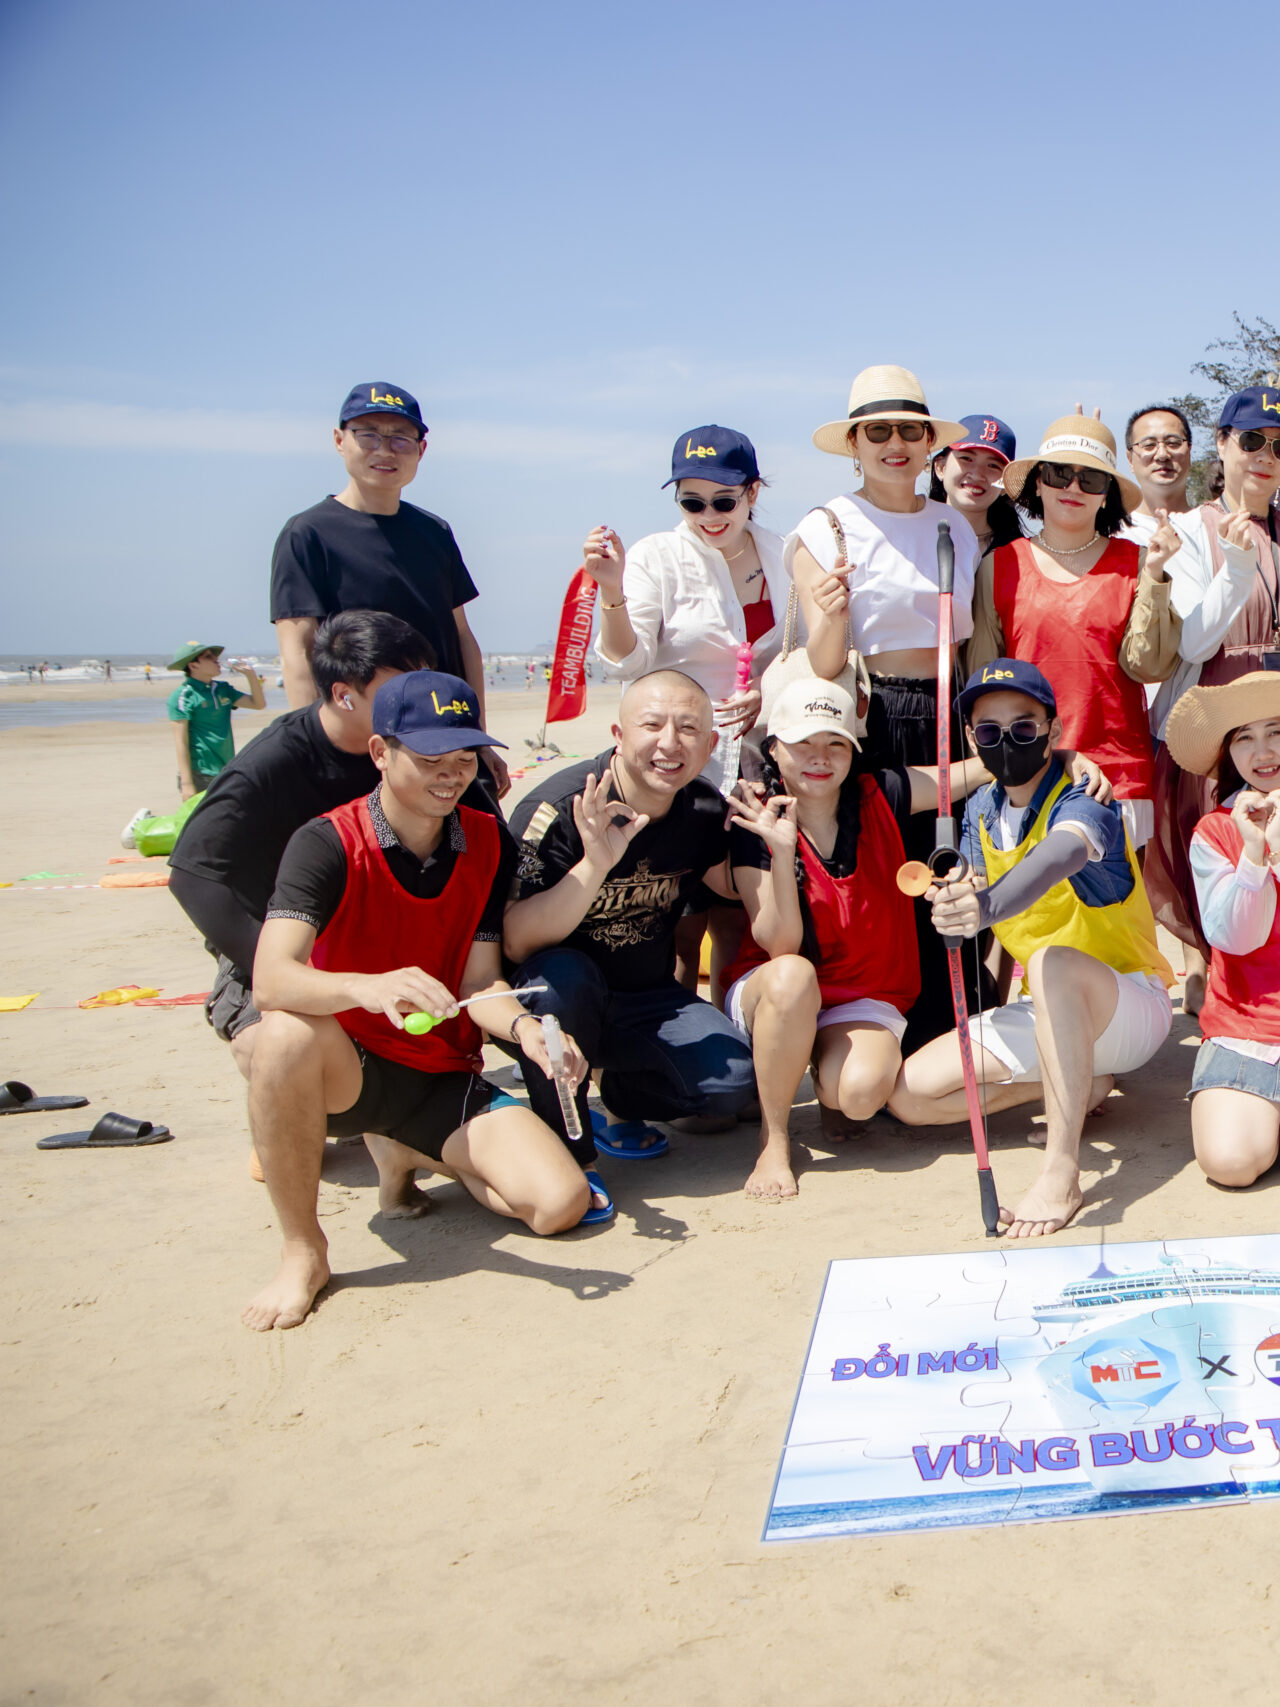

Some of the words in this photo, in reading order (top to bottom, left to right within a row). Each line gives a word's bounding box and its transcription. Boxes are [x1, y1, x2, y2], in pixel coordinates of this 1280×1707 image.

[979, 419, 999, 442] B
[1080, 438, 1099, 451] Dior
[560, 586, 597, 696] TEAMBUILDING
[804, 701, 842, 716] Vintage
[831, 1343, 910, 1382] ĐỔI
[917, 1342, 999, 1376] MỚI
[1090, 1360, 1162, 1384] MTC
[912, 1434, 1080, 1481] VỮNG
[1089, 1415, 1255, 1467] BƯỚC
